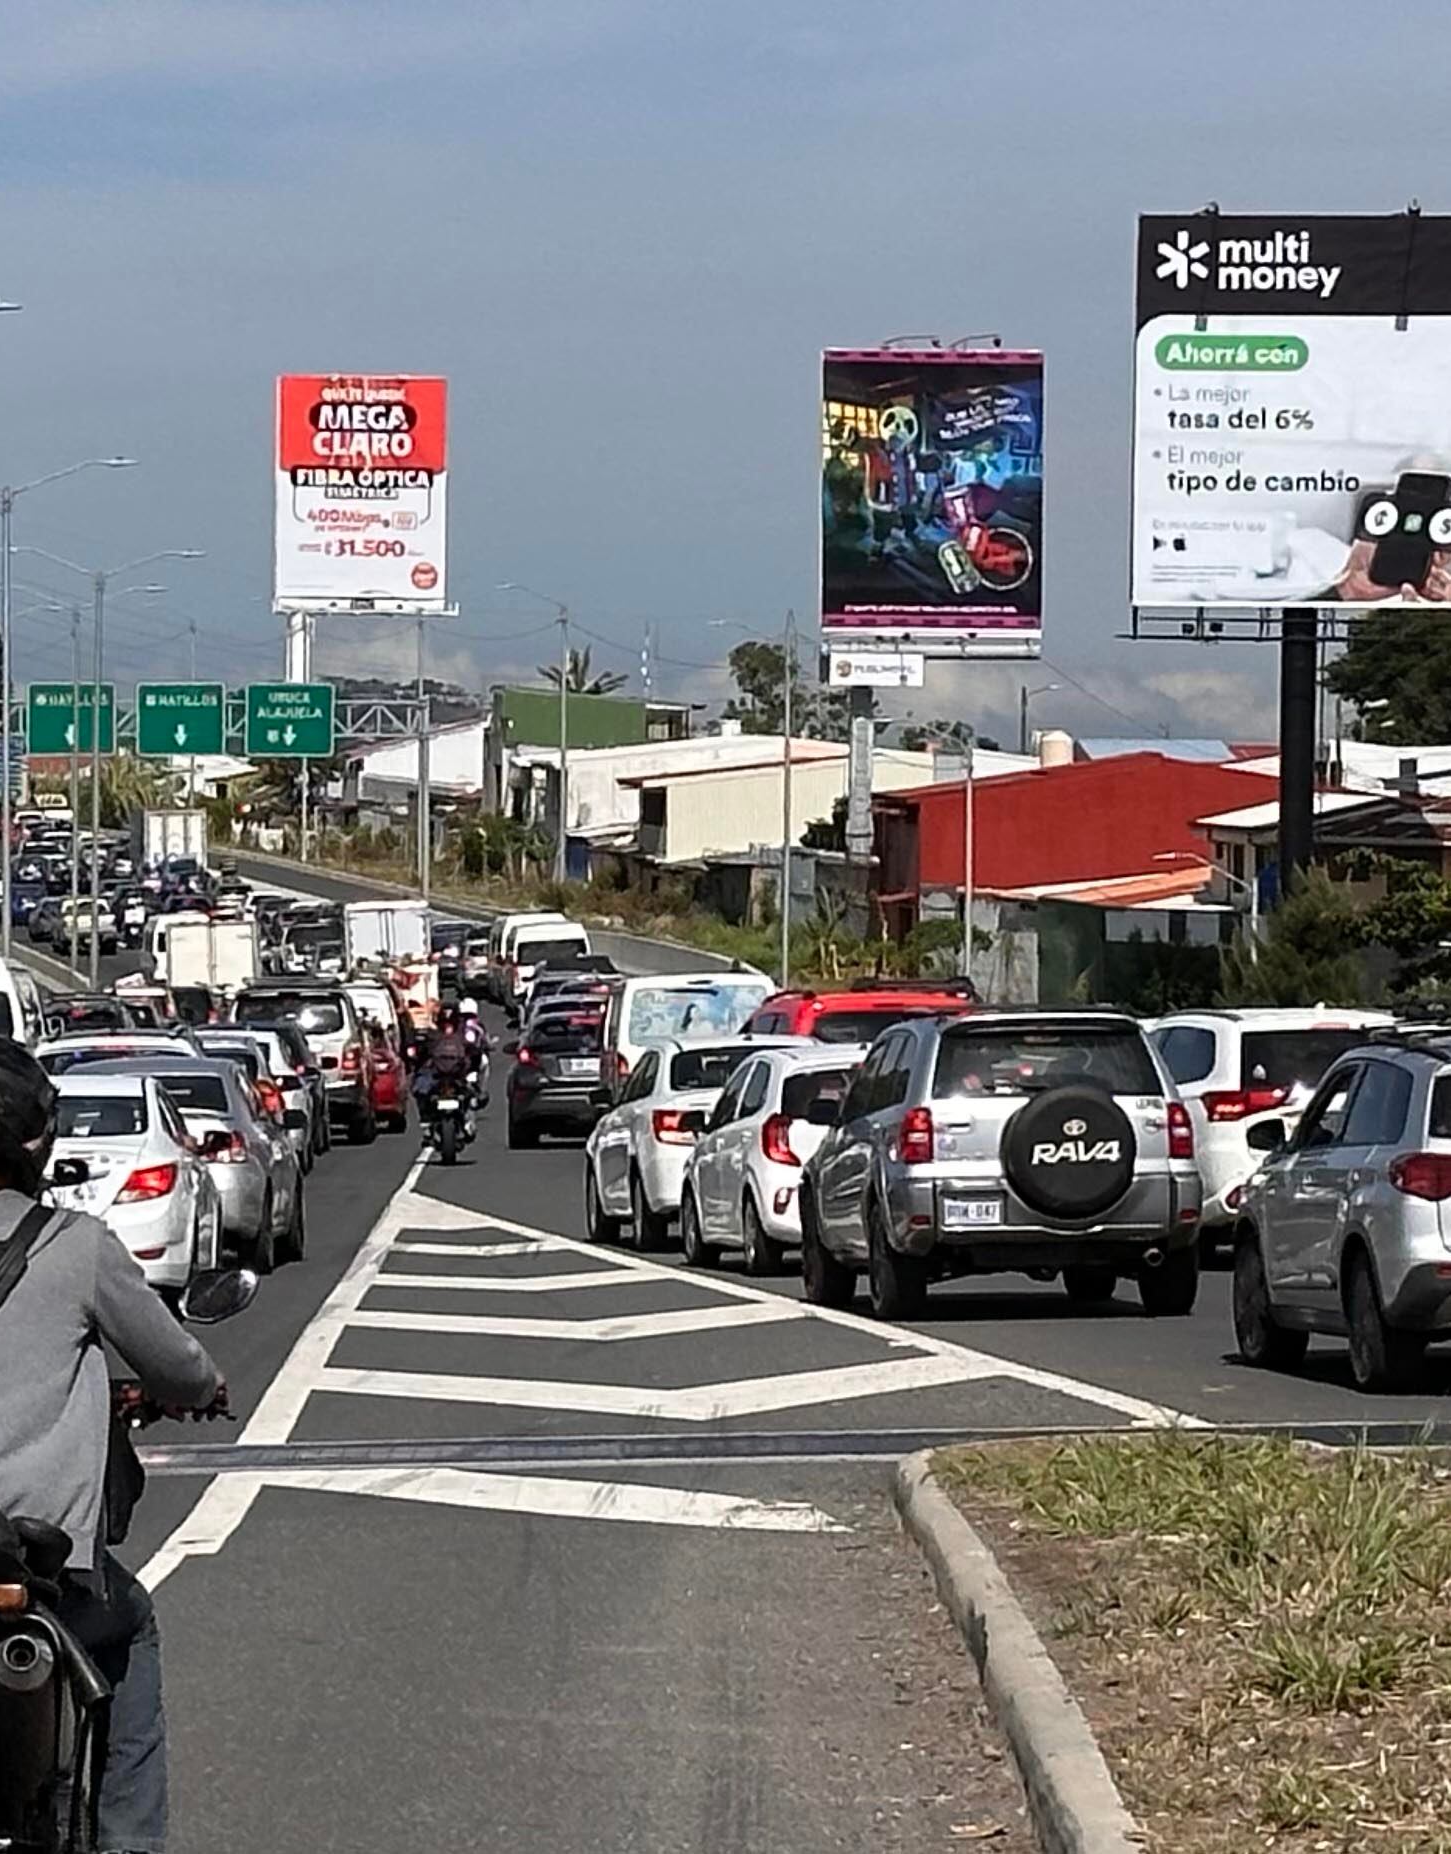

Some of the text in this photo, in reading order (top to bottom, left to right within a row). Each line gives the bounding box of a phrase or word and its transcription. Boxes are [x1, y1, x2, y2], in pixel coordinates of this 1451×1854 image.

[1218, 230, 1310, 264] multi
[1217, 266, 1342, 298] money
[1254, 348, 1299, 365] con
[1168, 384, 1250, 406] La mejor
[318, 404, 409, 431] MEGA
[1167, 406, 1315, 430] tasa del 6%
[312, 431, 414, 458] CLARO
[1167, 446, 1244, 469] El mejor
[296, 468, 356, 486] FIBRA
[1167, 468, 1361, 497] tipo de cambio
[1031, 1139, 1120, 1166] RAV4
